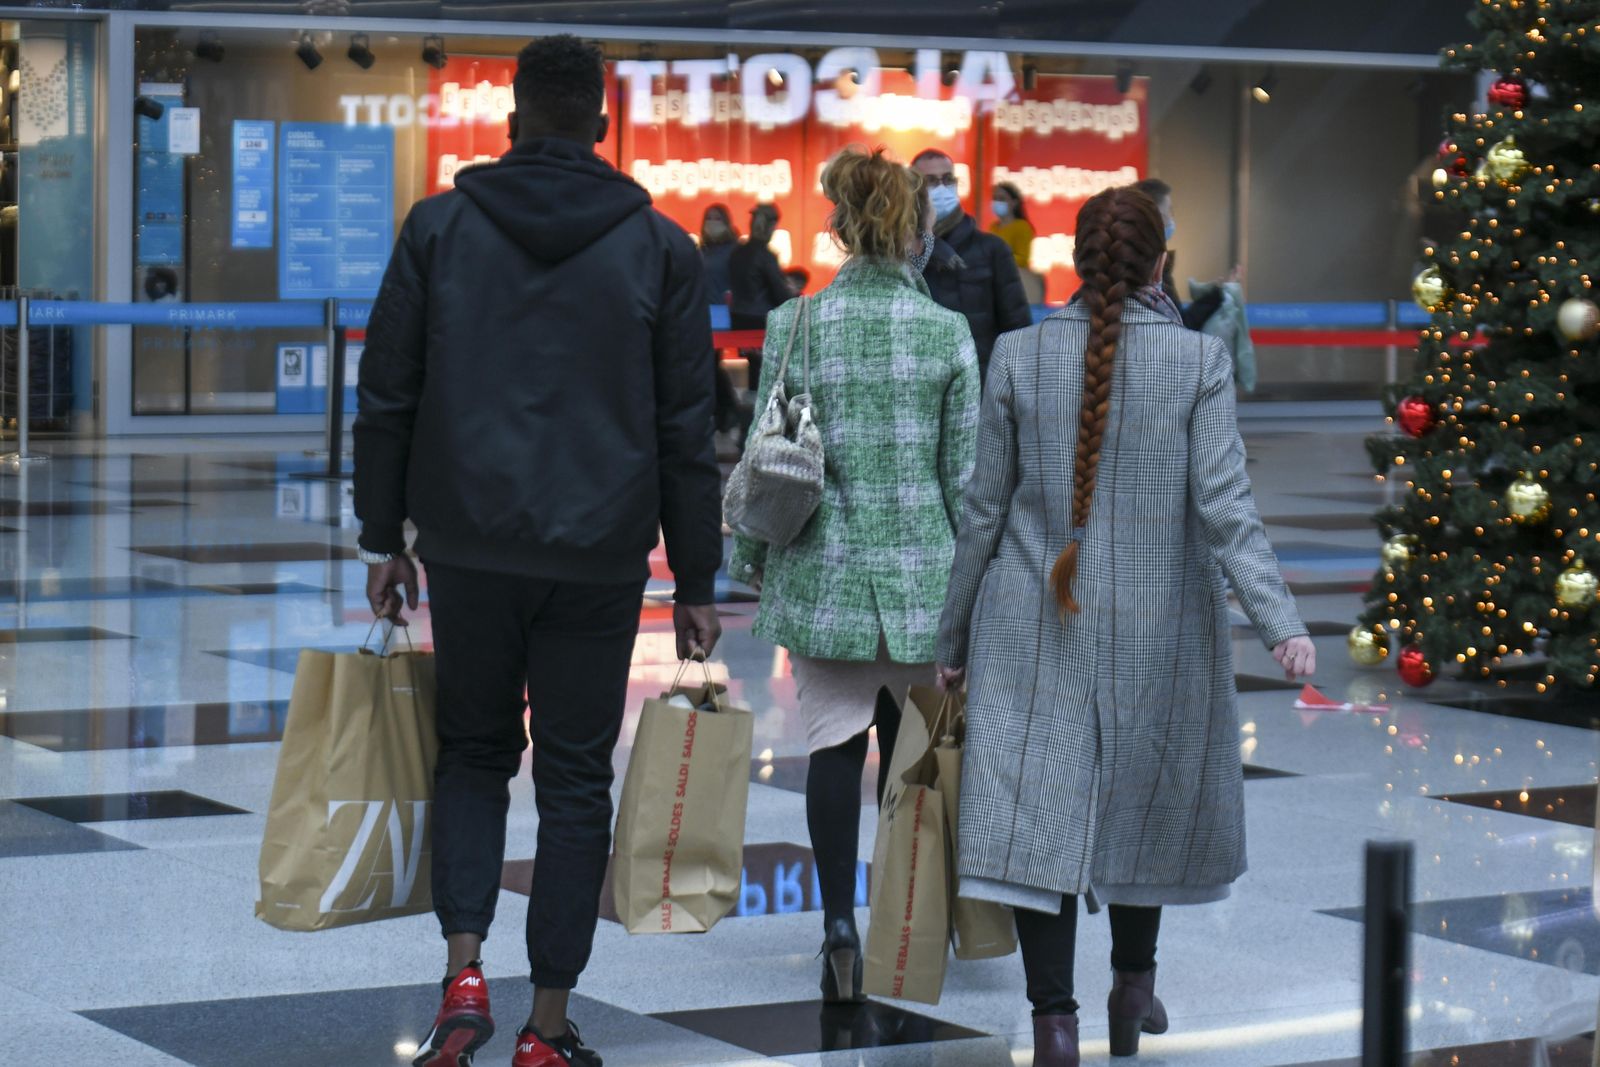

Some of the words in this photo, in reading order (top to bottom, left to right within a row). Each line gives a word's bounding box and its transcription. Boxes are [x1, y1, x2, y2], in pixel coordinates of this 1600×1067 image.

[169, 308, 237, 321] PRIMARK
[661, 903, 672, 931] SALE
[668, 803, 684, 847] SOLDES
[676, 763, 689, 798] SALDI
[683, 712, 698, 758] SALDOS
[896, 925, 912, 972] REBAJAS
[891, 974, 905, 998] SALE
